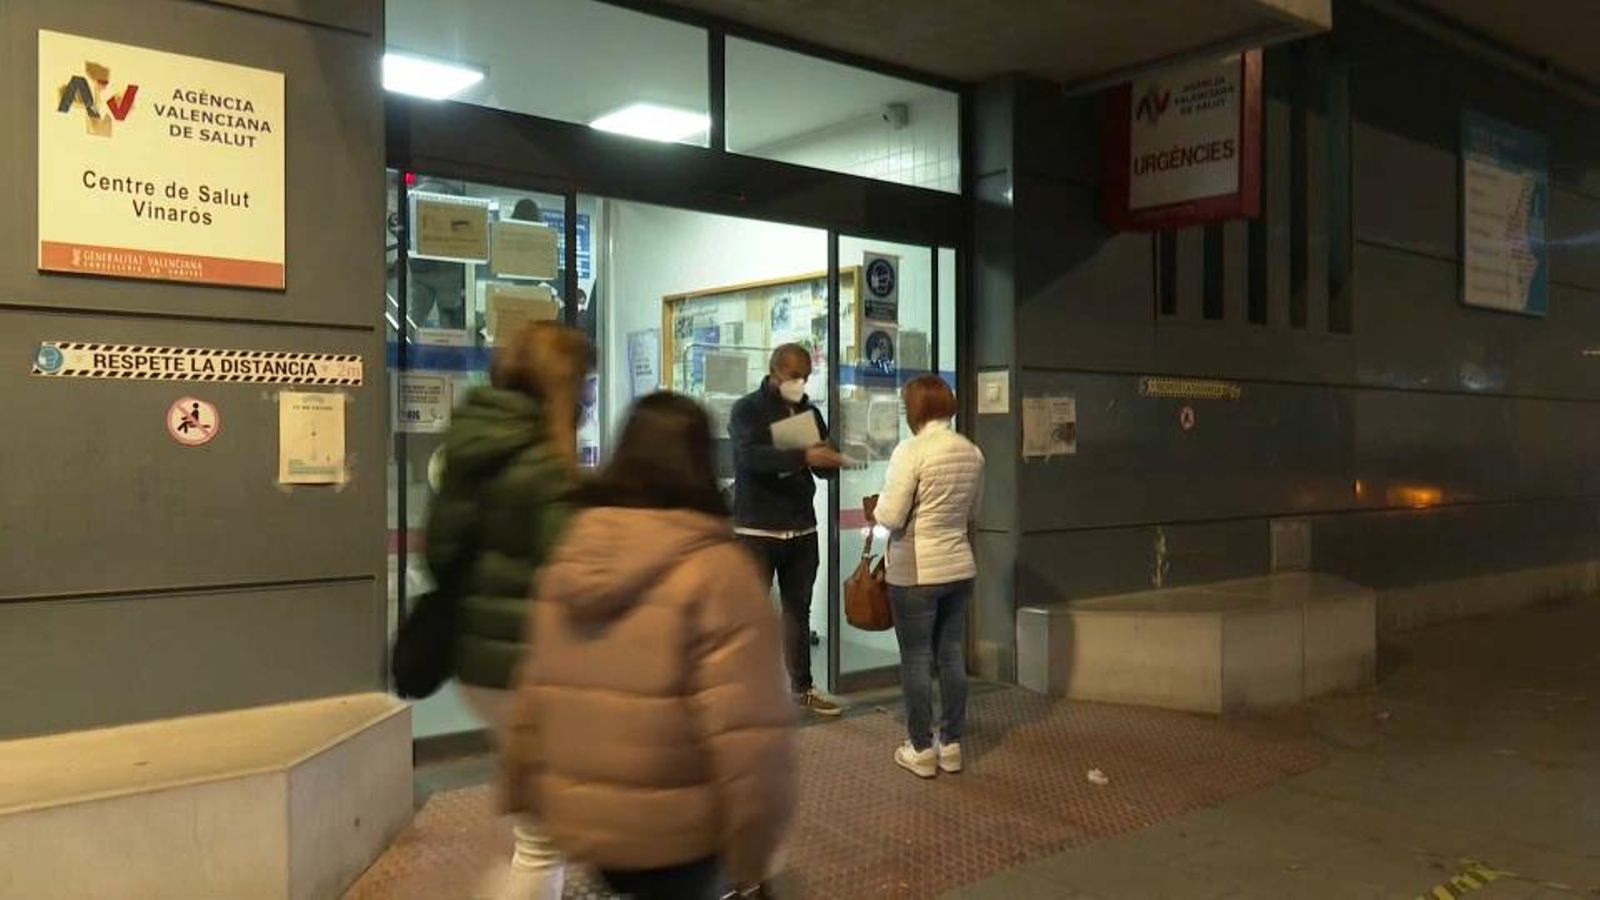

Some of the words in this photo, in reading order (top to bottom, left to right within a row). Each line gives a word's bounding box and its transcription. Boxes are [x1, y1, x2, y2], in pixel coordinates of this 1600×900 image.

[172, 88, 254, 113] AGÈNCIA
[154, 103, 272, 133] VALENCIANA
[169, 124, 193, 139] DE
[199, 128, 257, 148] SALUT
[1134, 139, 1234, 176] URGÈNCIES
[82, 170, 155, 196] Centre
[165, 182, 189, 200] de
[199, 185, 250, 208] Salut
[93, 353, 184, 372] RESPETE
[191, 358, 215, 374] LA
[220, 359, 318, 377] DISTANCIA
